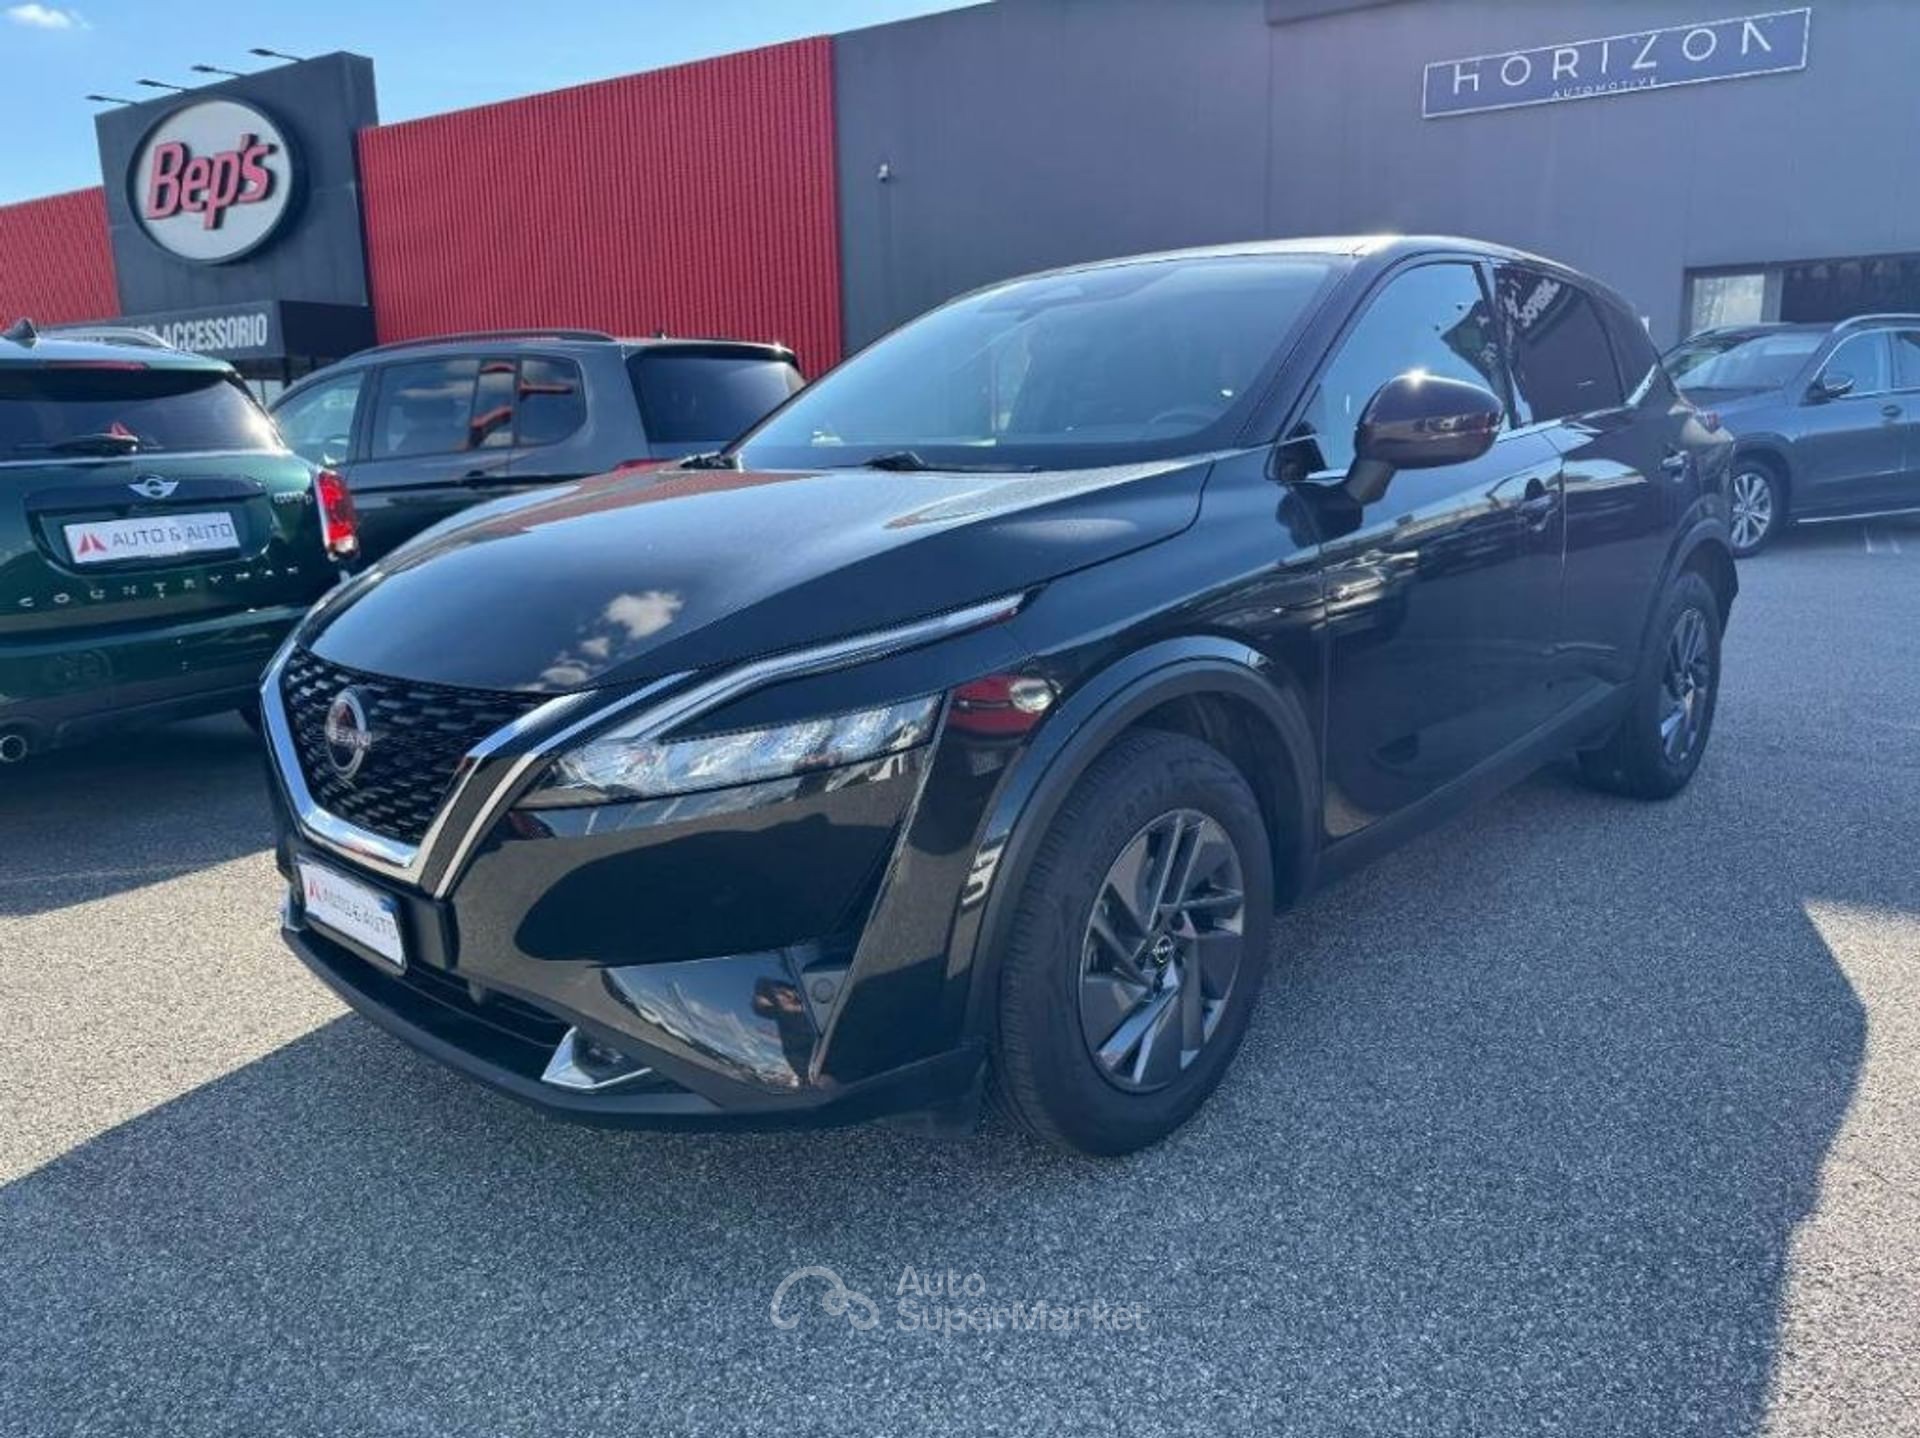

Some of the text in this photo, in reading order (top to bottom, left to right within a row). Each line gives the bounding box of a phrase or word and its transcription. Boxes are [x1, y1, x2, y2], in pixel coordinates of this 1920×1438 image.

[1452, 20, 1772, 94] HORIZON
[1552, 77, 1658, 98] AUTOMOTIVE
[145, 133, 277, 230] Bep's
[162, 313, 268, 351] ACCESSORIO
[112, 522, 234, 547] AUTO & AUTO
[19, 566, 299, 608] COUNTRYMAN
